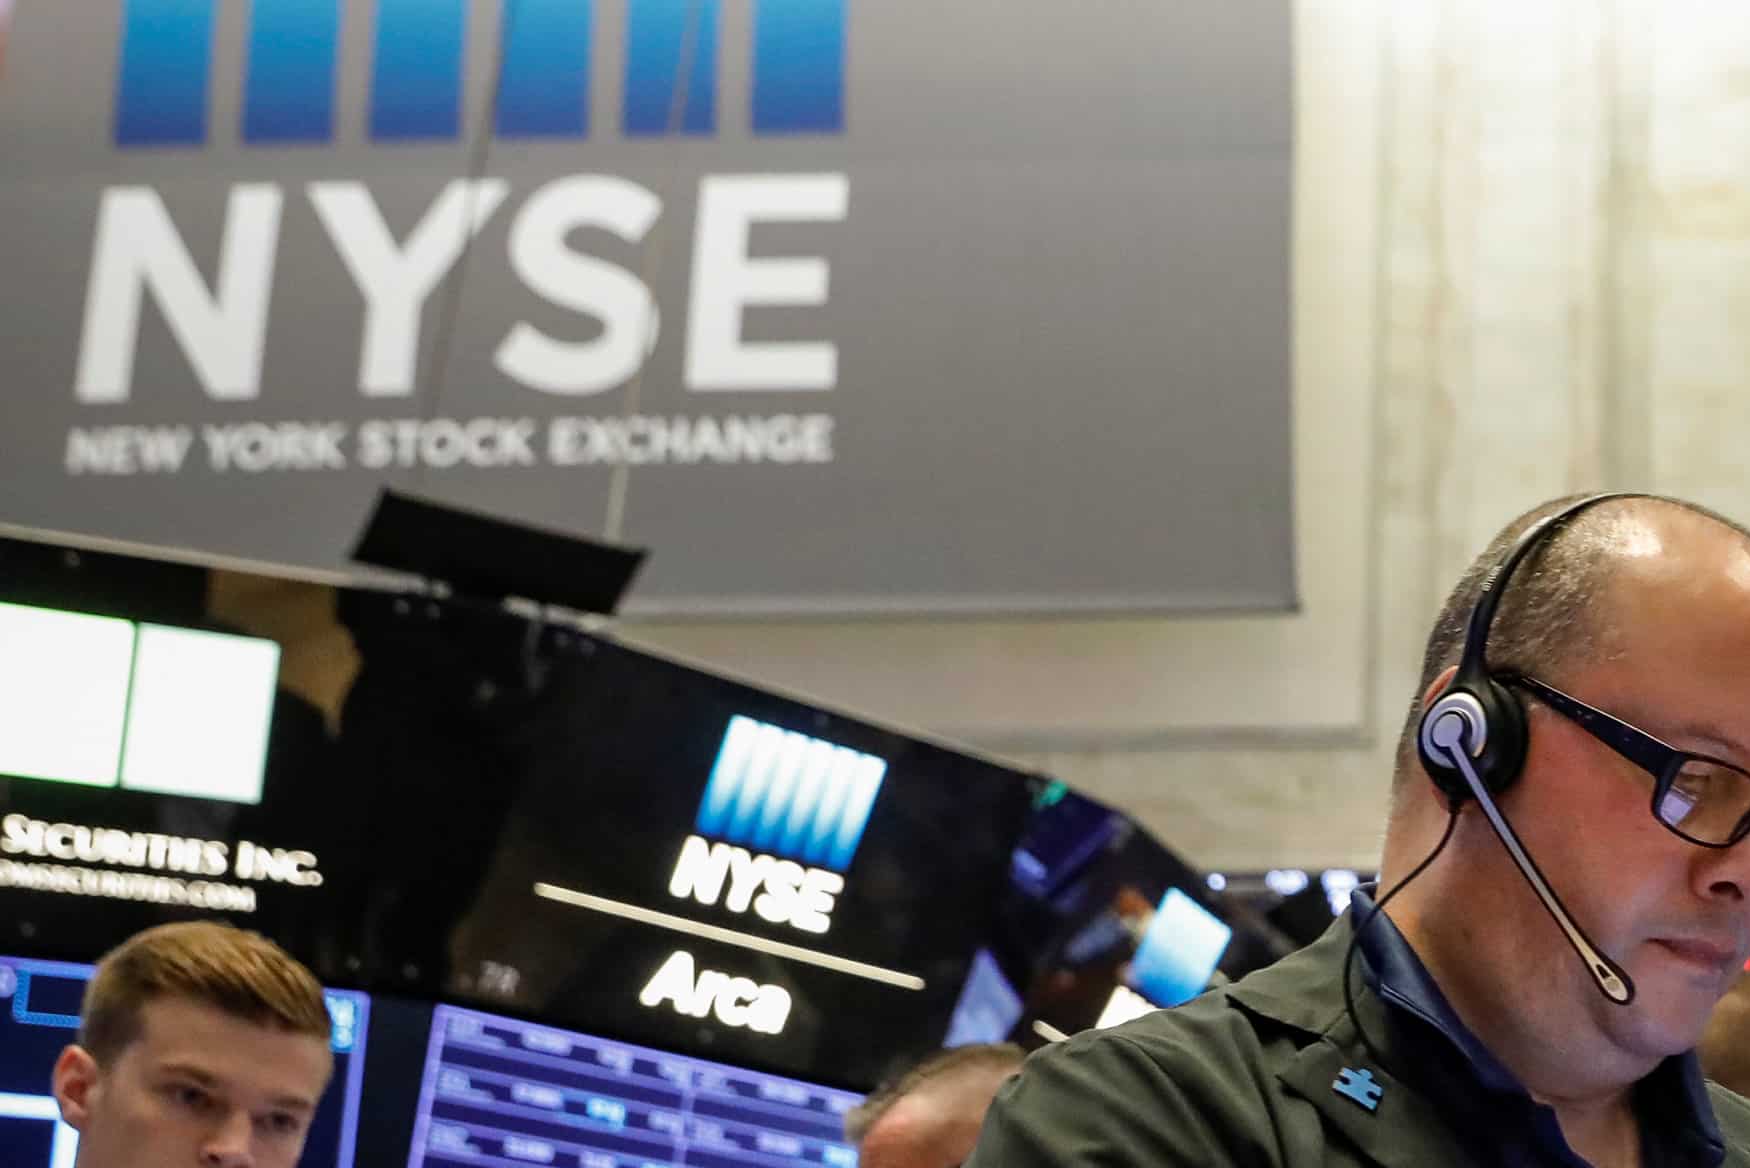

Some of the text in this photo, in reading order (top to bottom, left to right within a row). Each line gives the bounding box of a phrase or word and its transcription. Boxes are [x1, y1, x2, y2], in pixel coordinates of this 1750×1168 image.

[74, 171, 851, 404] NYSE
[66, 413, 837, 475] NEW YORK STOCK EXCHANGE
[668, 835, 845, 935] NYSE
[638, 950, 794, 1036] Arca
